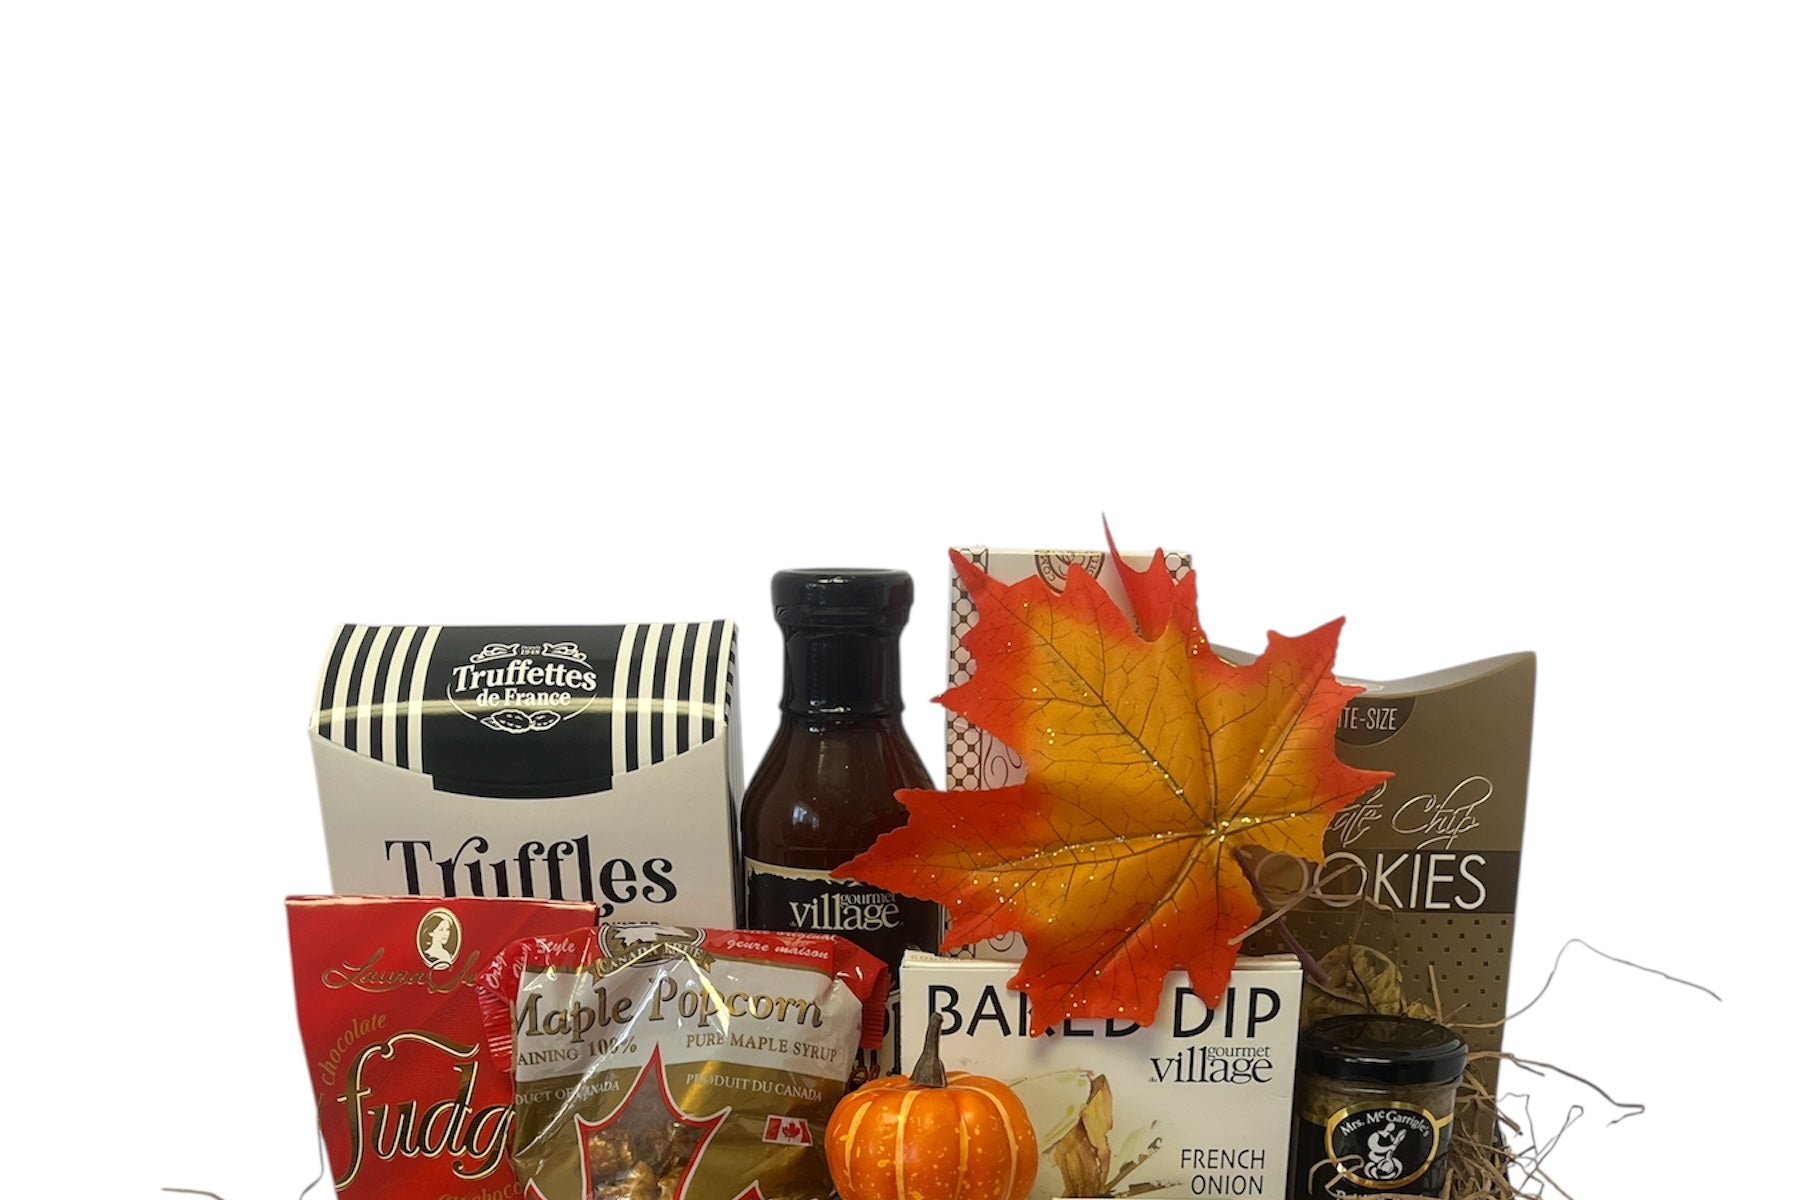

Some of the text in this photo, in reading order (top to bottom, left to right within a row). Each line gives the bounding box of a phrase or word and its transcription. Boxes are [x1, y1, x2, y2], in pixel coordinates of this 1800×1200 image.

[452, 659, 598, 692] Truffettes
[476, 687, 572, 707] de France
[1338, 707, 1398, 731] ITE-SIZE
[1392, 776, 1493, 850] Chip
[384, 835, 678, 908] Truffles
[1256, 851, 1488, 910] OOKIES
[789, 893, 900, 931] village
[841, 892, 896, 908] gourmet
[536, 937, 576, 956] Style
[321, 947, 425, 993] Laura
[648, 975, 824, 1028] Popcorn
[1173, 987, 1282, 1038] DIP
[321, 1012, 388, 1087] chocolate
[518, 1048, 579, 1066] AINING
[686, 1032, 838, 1062] PURE MAPLE SYRUP
[1207, 1046, 1271, 1060] gourmet
[1150, 1046, 1273, 1084] village
[515, 1091, 551, 1105] DUCT
[686, 1073, 823, 1102] PRODUIT DU CANADA
[335, 1029, 517, 1191] fudg
[1340, 1117, 1366, 1137] Mrs.
[1181, 1149, 1266, 1170] FRENCH
[1191, 1174, 1265, 1196] ONION
